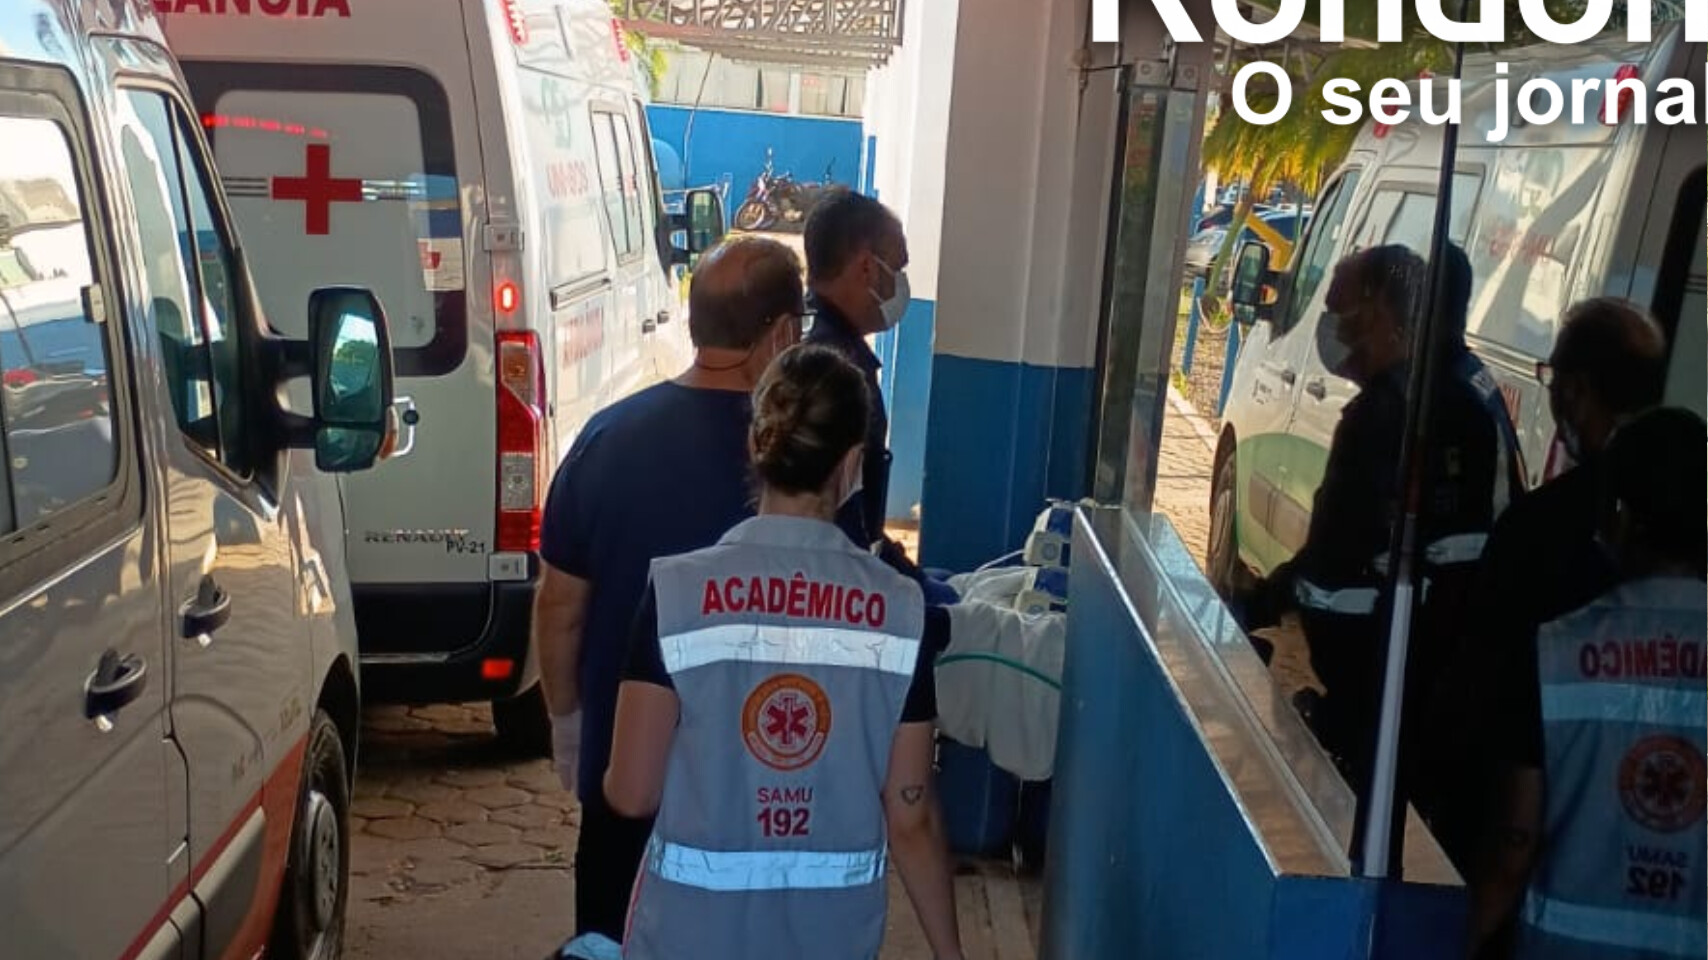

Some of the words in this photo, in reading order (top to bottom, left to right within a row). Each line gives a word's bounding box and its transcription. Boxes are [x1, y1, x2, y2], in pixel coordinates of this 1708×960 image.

[446, 540, 485, 554] PV-21
[702, 571, 886, 628] ACADÊMICO
[757, 787, 814, 804] SAMU
[757, 808, 810, 837] 192
